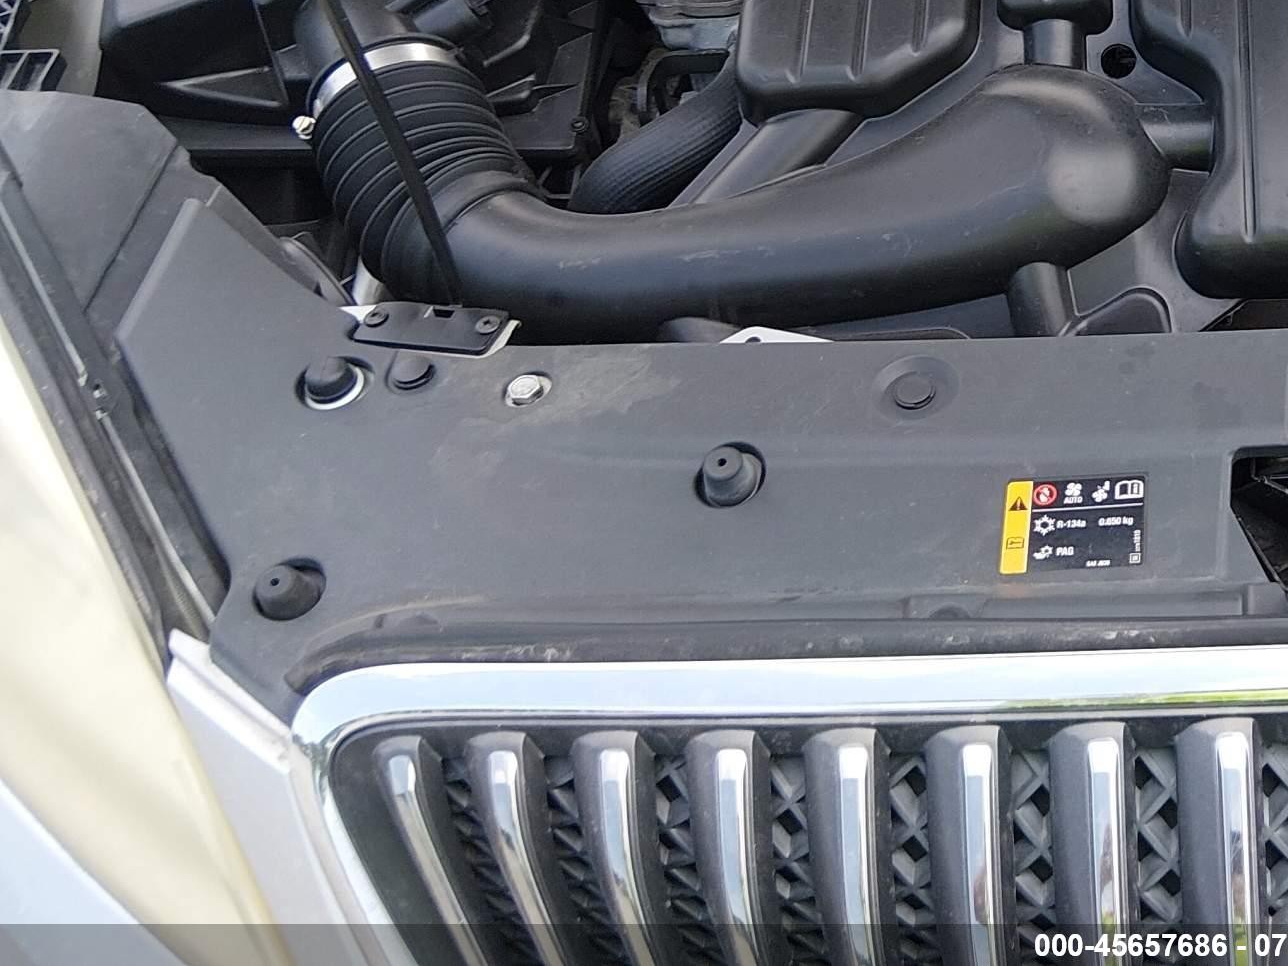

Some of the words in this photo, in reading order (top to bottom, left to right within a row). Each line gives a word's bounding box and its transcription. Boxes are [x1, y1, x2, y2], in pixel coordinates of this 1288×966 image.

[1063, 496, 1083, 505] AUTO
[1056, 518, 1087, 529] R-134a
[1056, 546, 1075, 557] PAG
